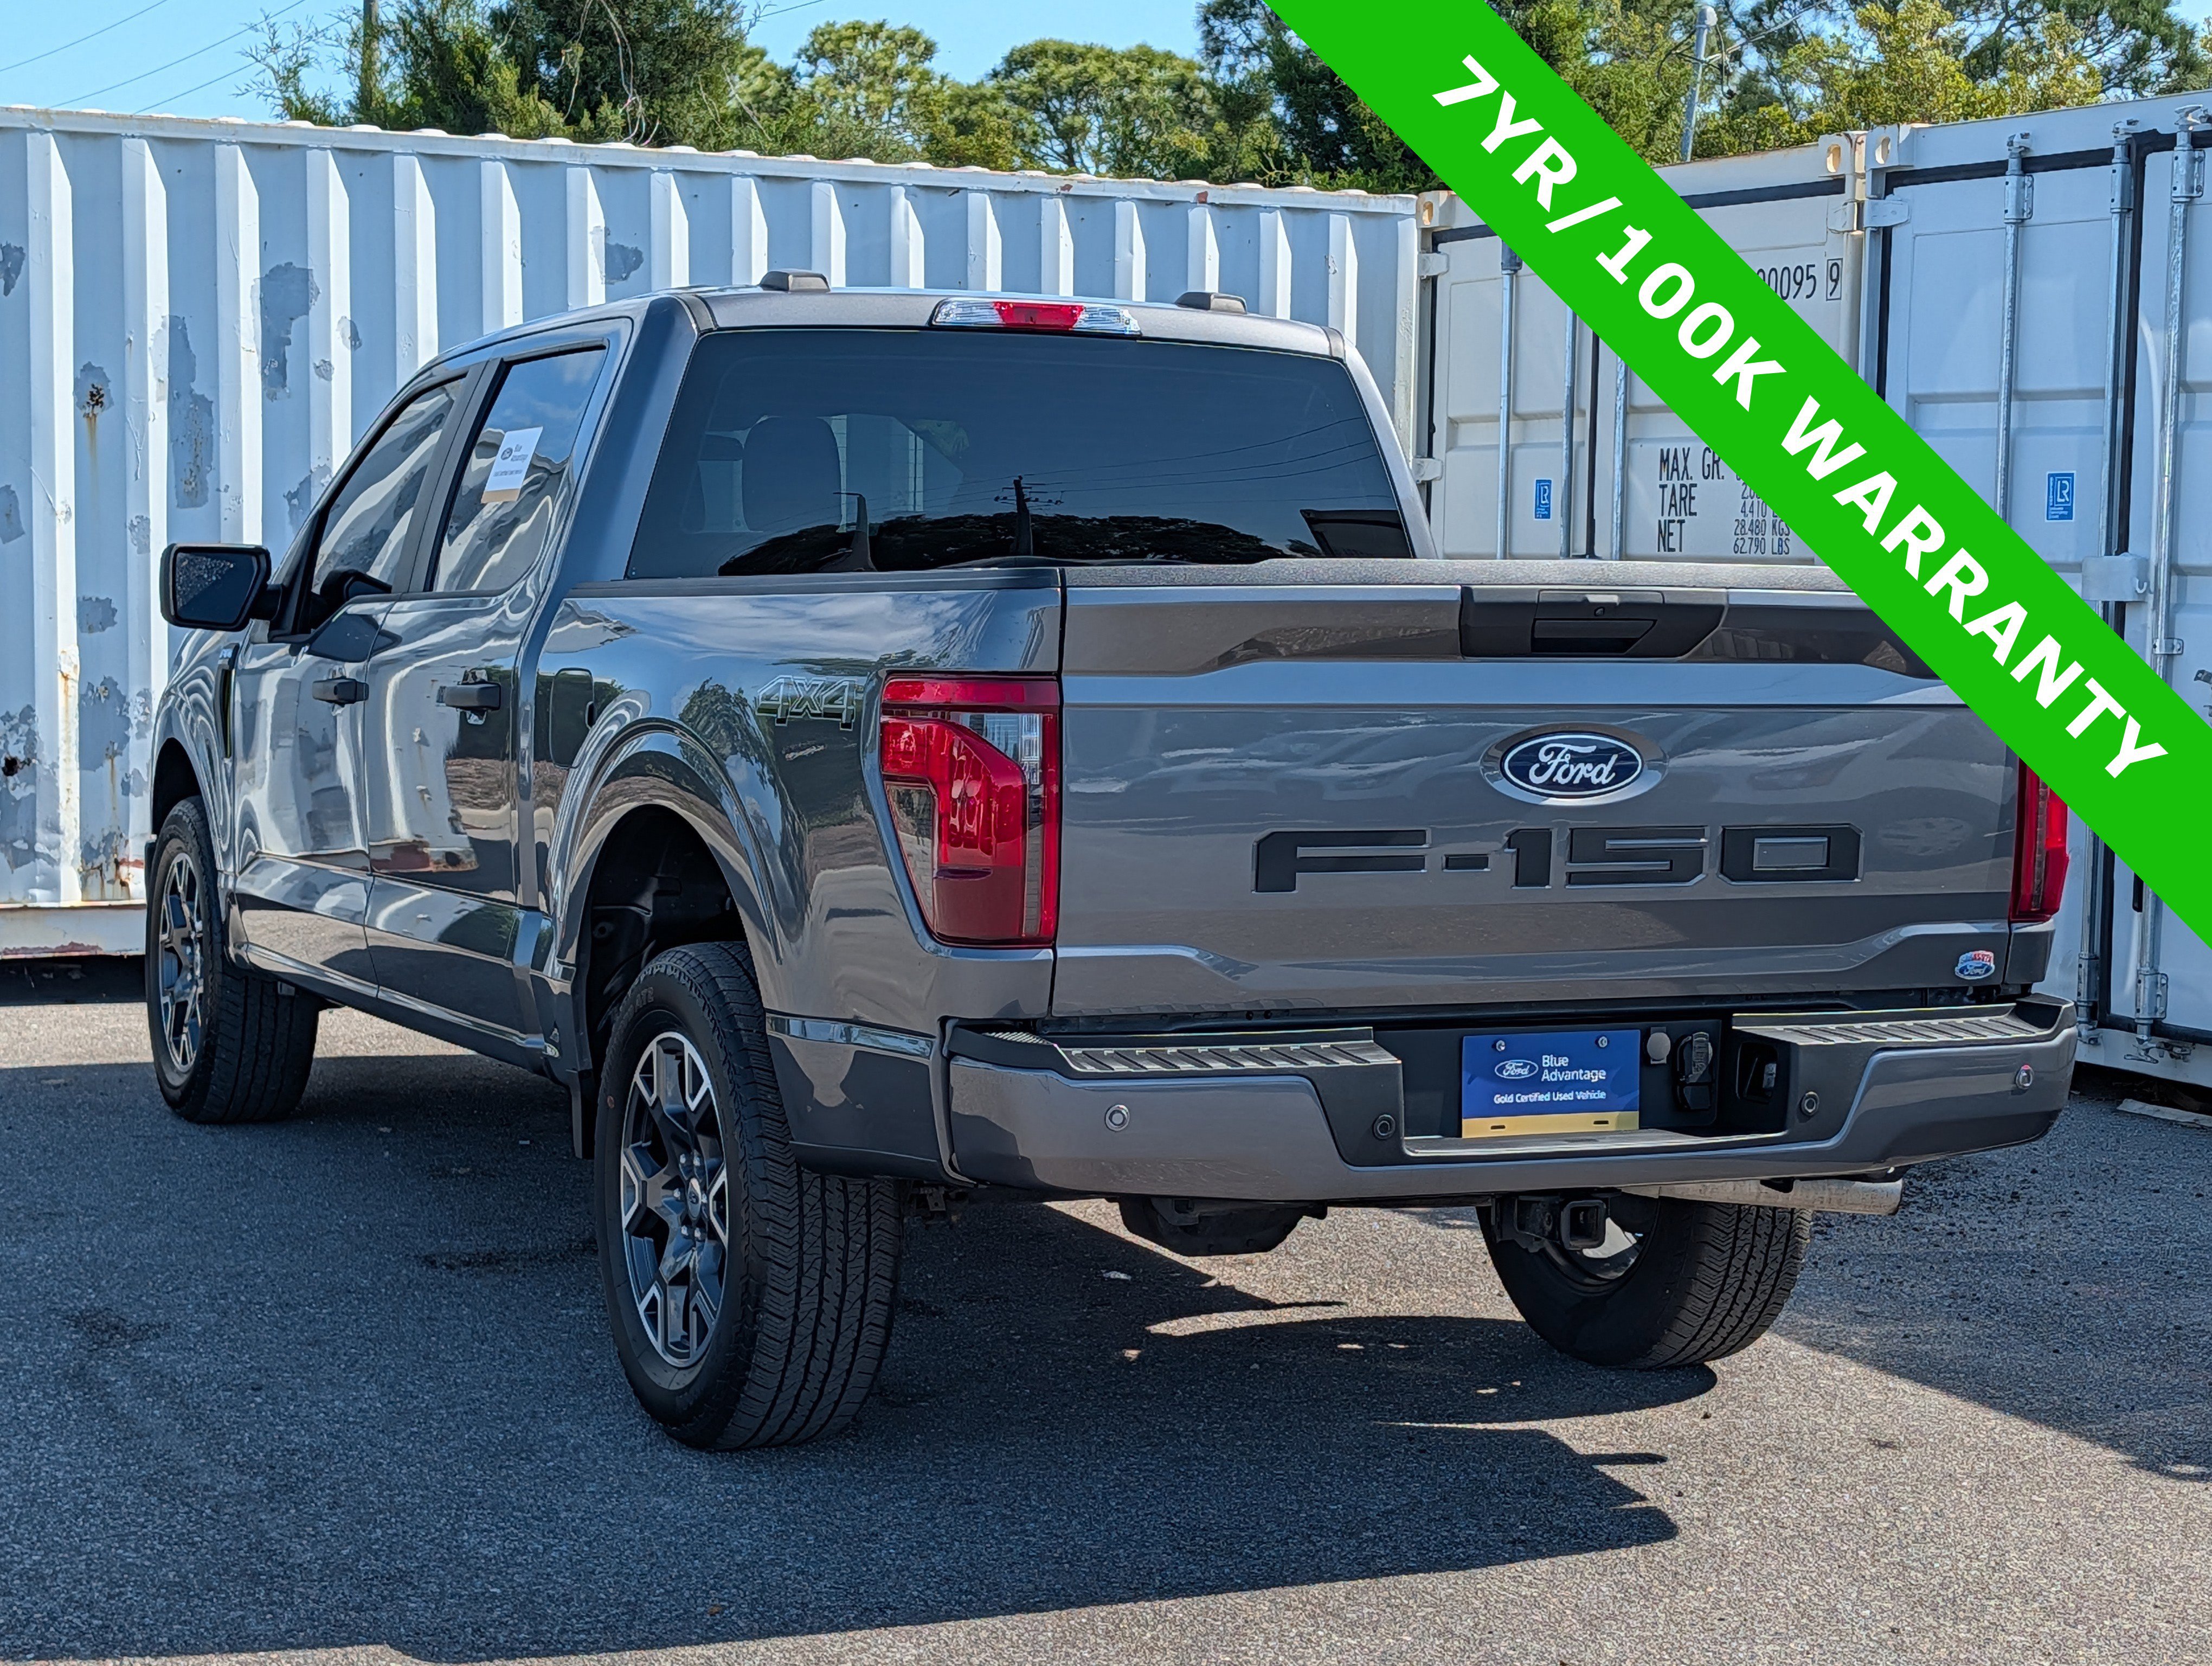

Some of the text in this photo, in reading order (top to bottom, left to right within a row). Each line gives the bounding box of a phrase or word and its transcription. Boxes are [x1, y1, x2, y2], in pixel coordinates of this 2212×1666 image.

[1829, 262, 1840, 297] 9
[1659, 446, 1725, 481] MAX. GR.
[1659, 483, 1697, 517] TARE
[1657, 519, 1686, 552] NET
[1771, 537, 1790, 555] LBS
[1528, 742, 1618, 785] Ford
[1251, 823, 1864, 894] F-150
[1503, 1055, 1568, 1076] Ford Blue
[1541, 1069, 1606, 1082] Advantage
[1494, 1090, 1606, 1104] Gold Certified Used Vehicle
